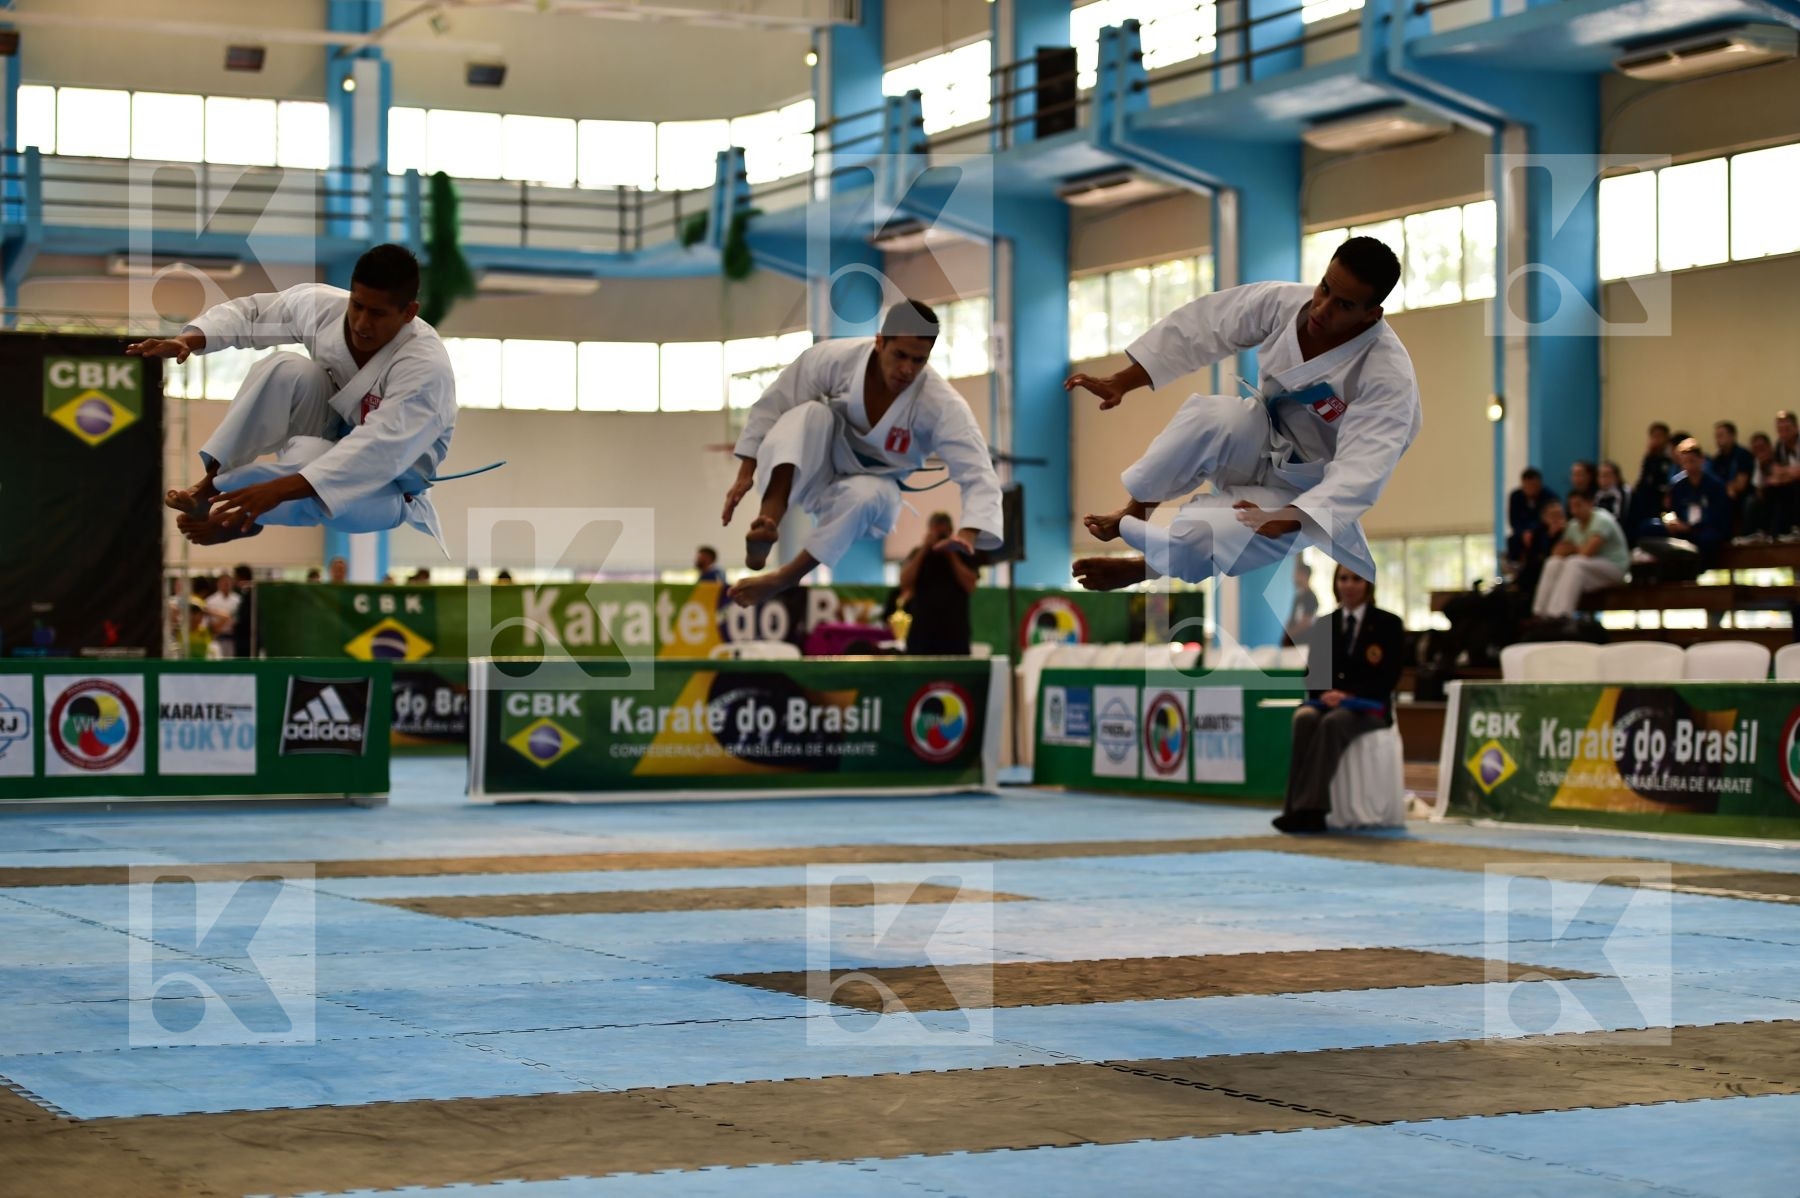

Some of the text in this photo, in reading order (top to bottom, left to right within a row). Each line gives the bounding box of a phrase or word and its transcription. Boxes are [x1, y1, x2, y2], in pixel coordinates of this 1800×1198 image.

[50, 361, 135, 388] CBK
[521, 588, 709, 647] Karate
[160, 703, 223, 720] KARATE
[395, 688, 427, 716] do
[506, 693, 582, 717] CBK
[610, 697, 726, 734] Karate
[736, 698, 776, 733] do
[786, 697, 882, 733] Brasil
[161, 722, 255, 752] TOKYO
[285, 720, 362, 740] adidas
[1469, 711, 1522, 739] CBK
[1539, 717, 1758, 764] Karate do Brasil
[1689, 776, 1705, 793] DE
[1707, 777, 1753, 795] KARATE
